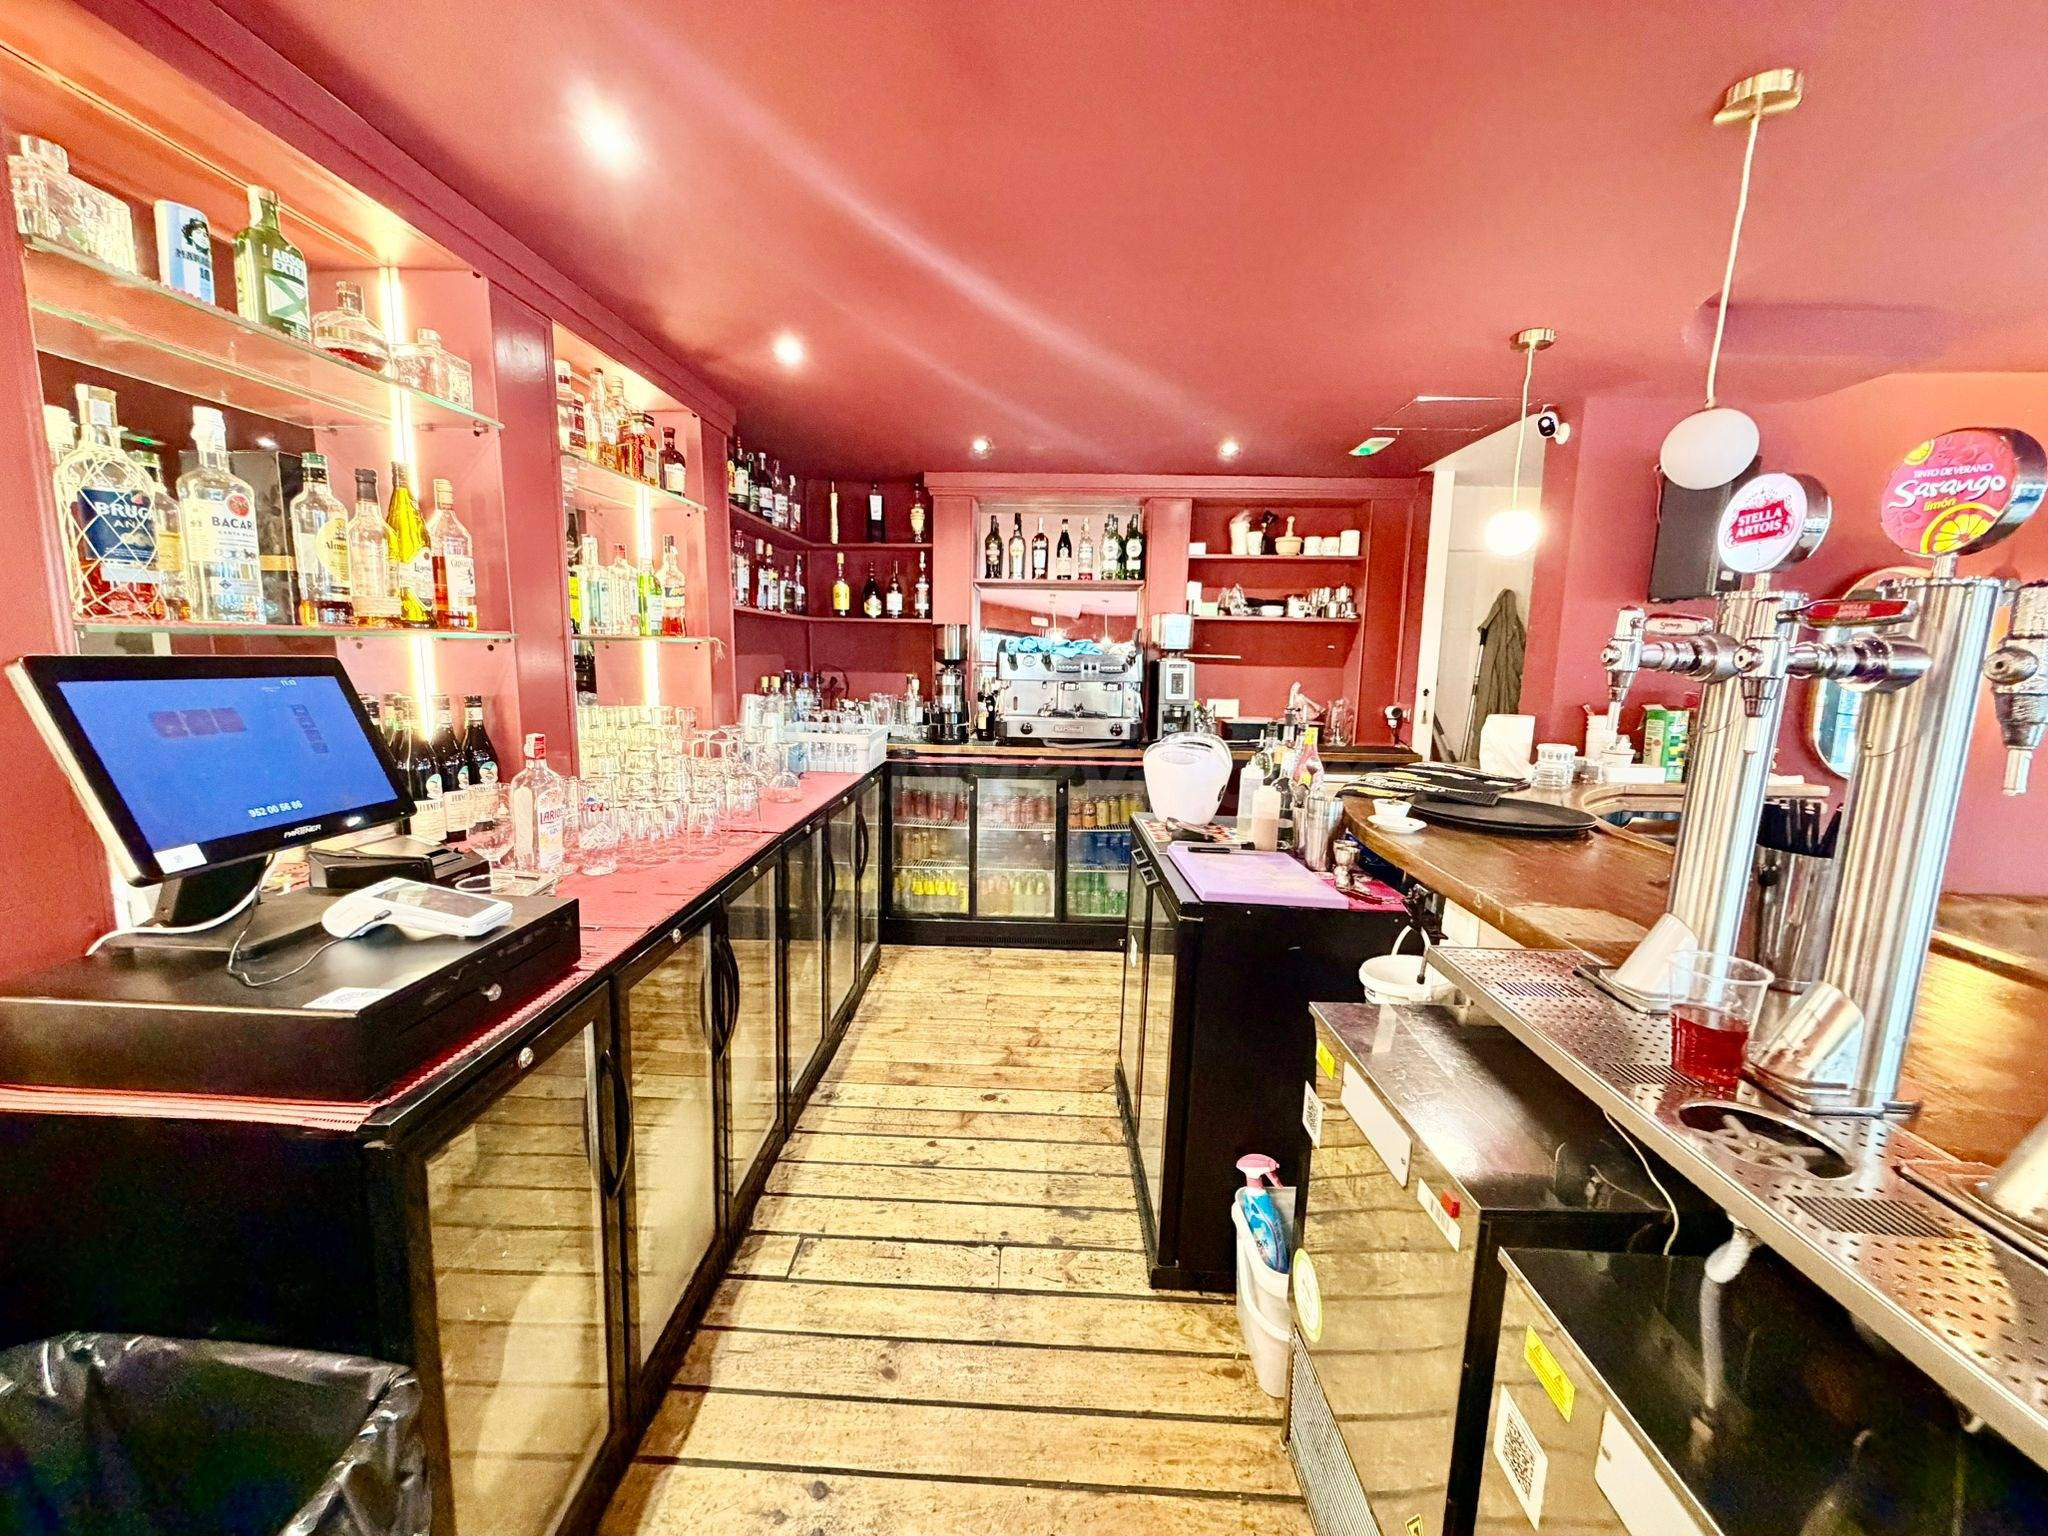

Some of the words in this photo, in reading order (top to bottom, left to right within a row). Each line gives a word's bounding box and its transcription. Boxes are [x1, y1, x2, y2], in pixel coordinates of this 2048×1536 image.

[1914, 469, 1938, 478] TINTO
[1942, 467, 1953, 476] DE
[1953, 463, 1994, 475] VERANO
[1888, 475, 2007, 509] Sarango
[1924, 497, 1957, 511] limón
[1738, 507, 1782, 526] STELLA
[1735, 520, 1782, 538] ARTOIS
[249, 808, 267, 818] 952
[267, 805, 279, 814] 00
